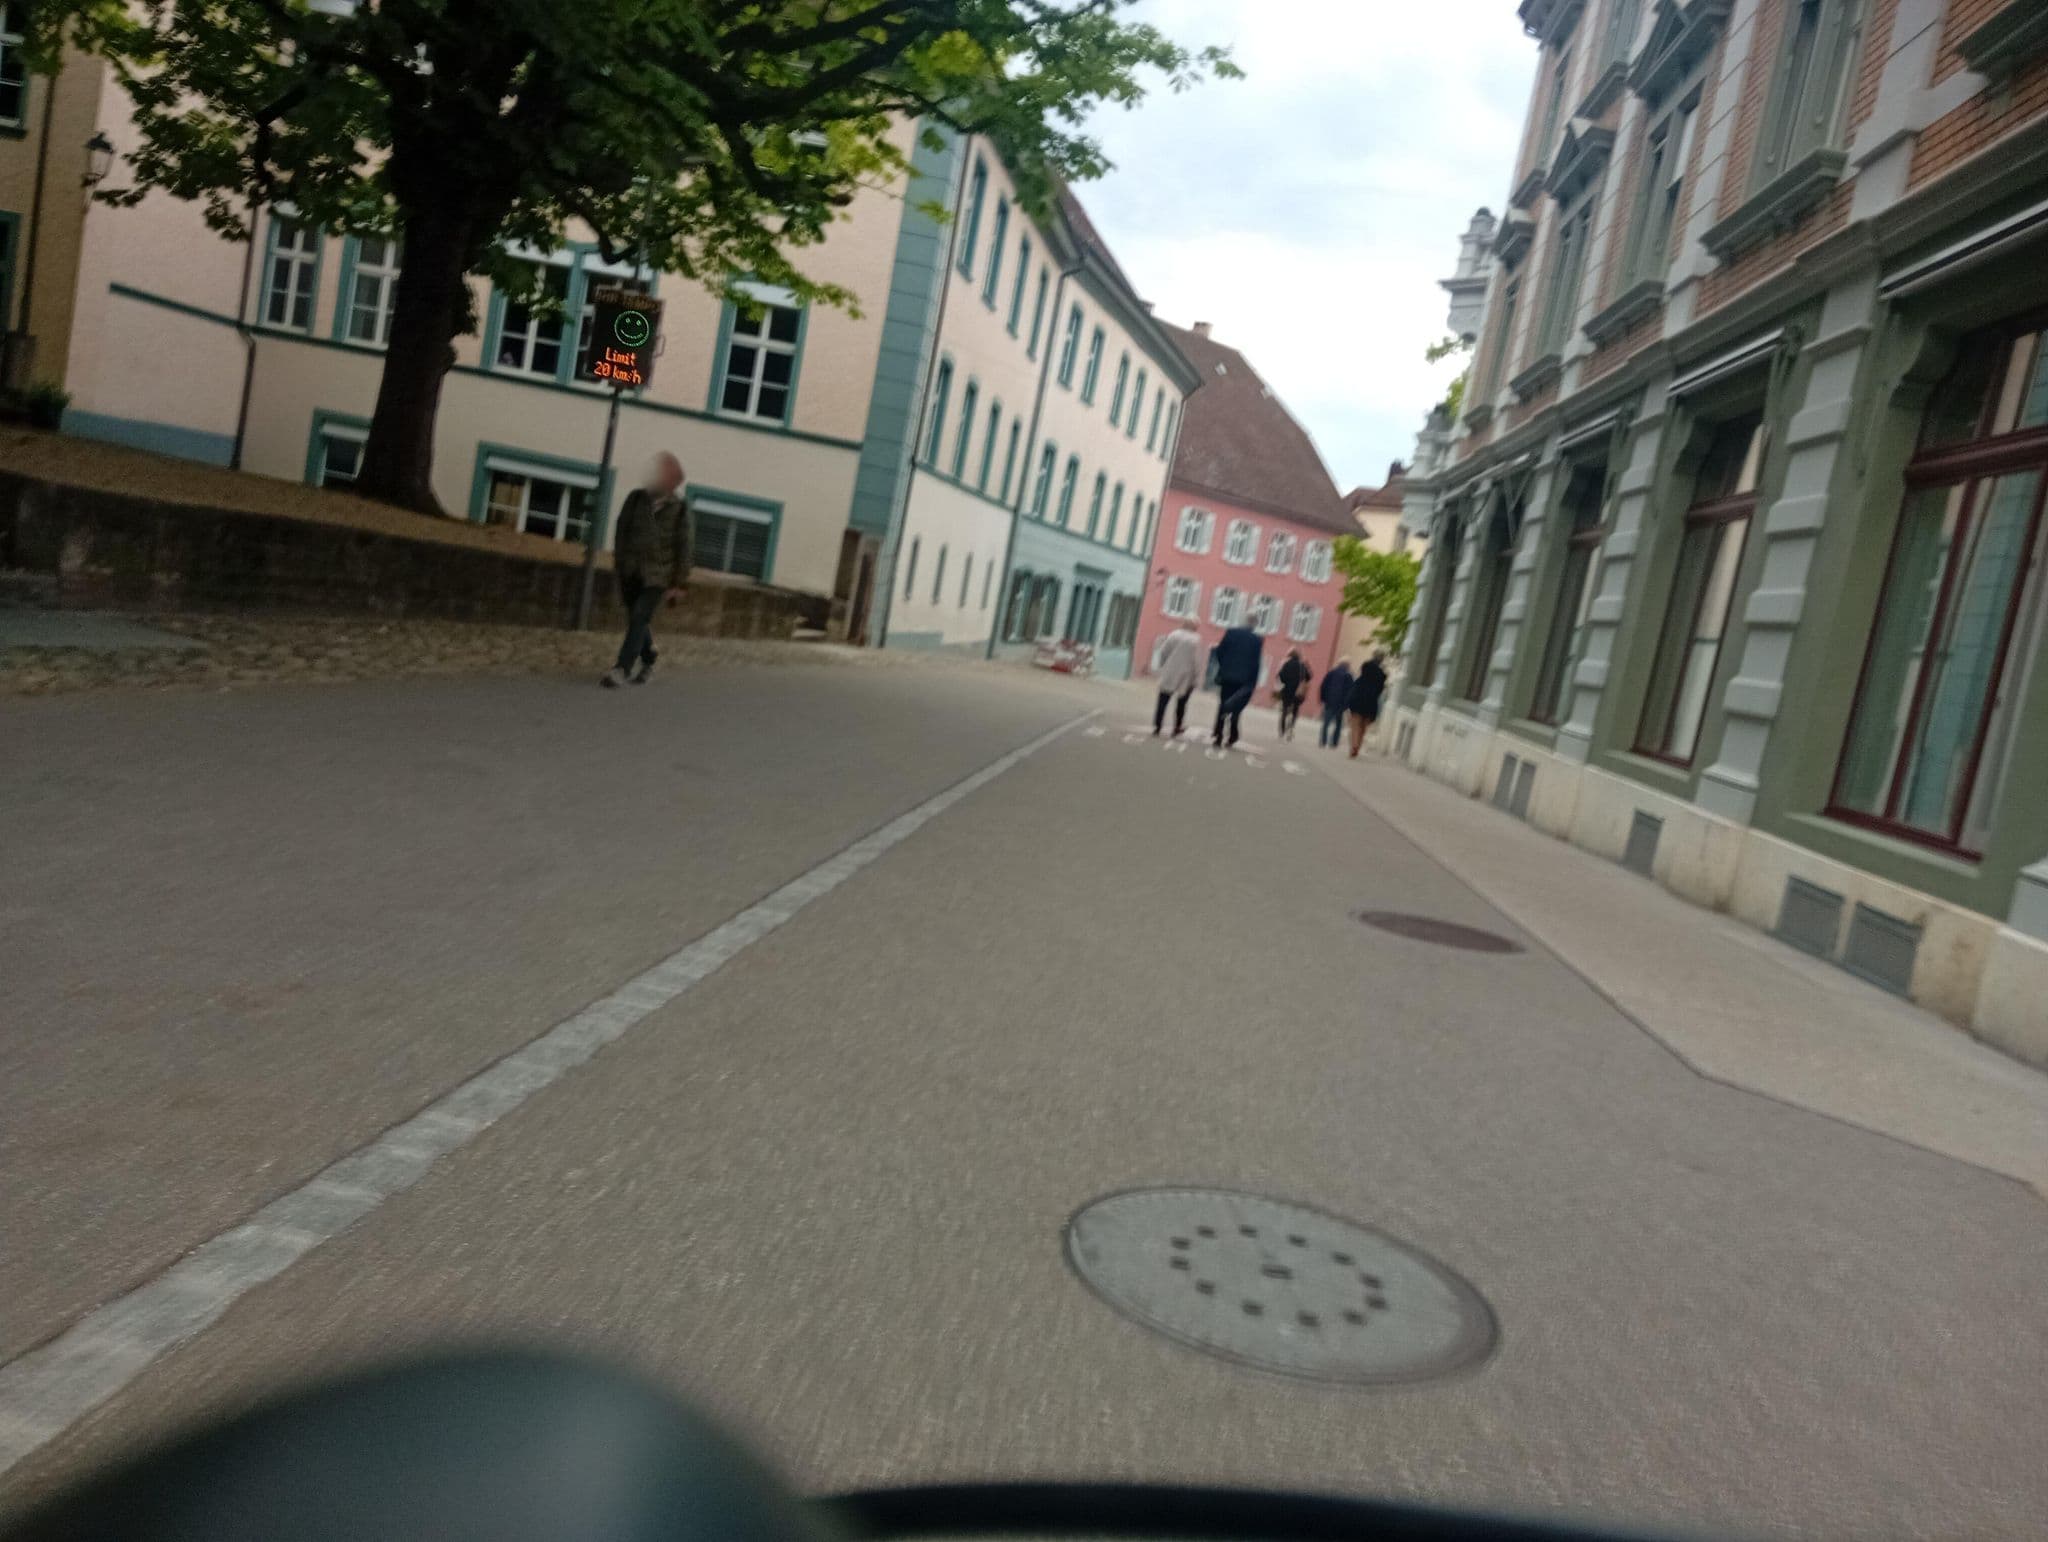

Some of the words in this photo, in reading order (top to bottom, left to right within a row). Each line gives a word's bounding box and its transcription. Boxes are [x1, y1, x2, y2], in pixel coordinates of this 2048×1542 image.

[605, 346, 637, 366] Limit
[593, 361, 611, 377] 20
[612, 365, 642, 385] km/h
